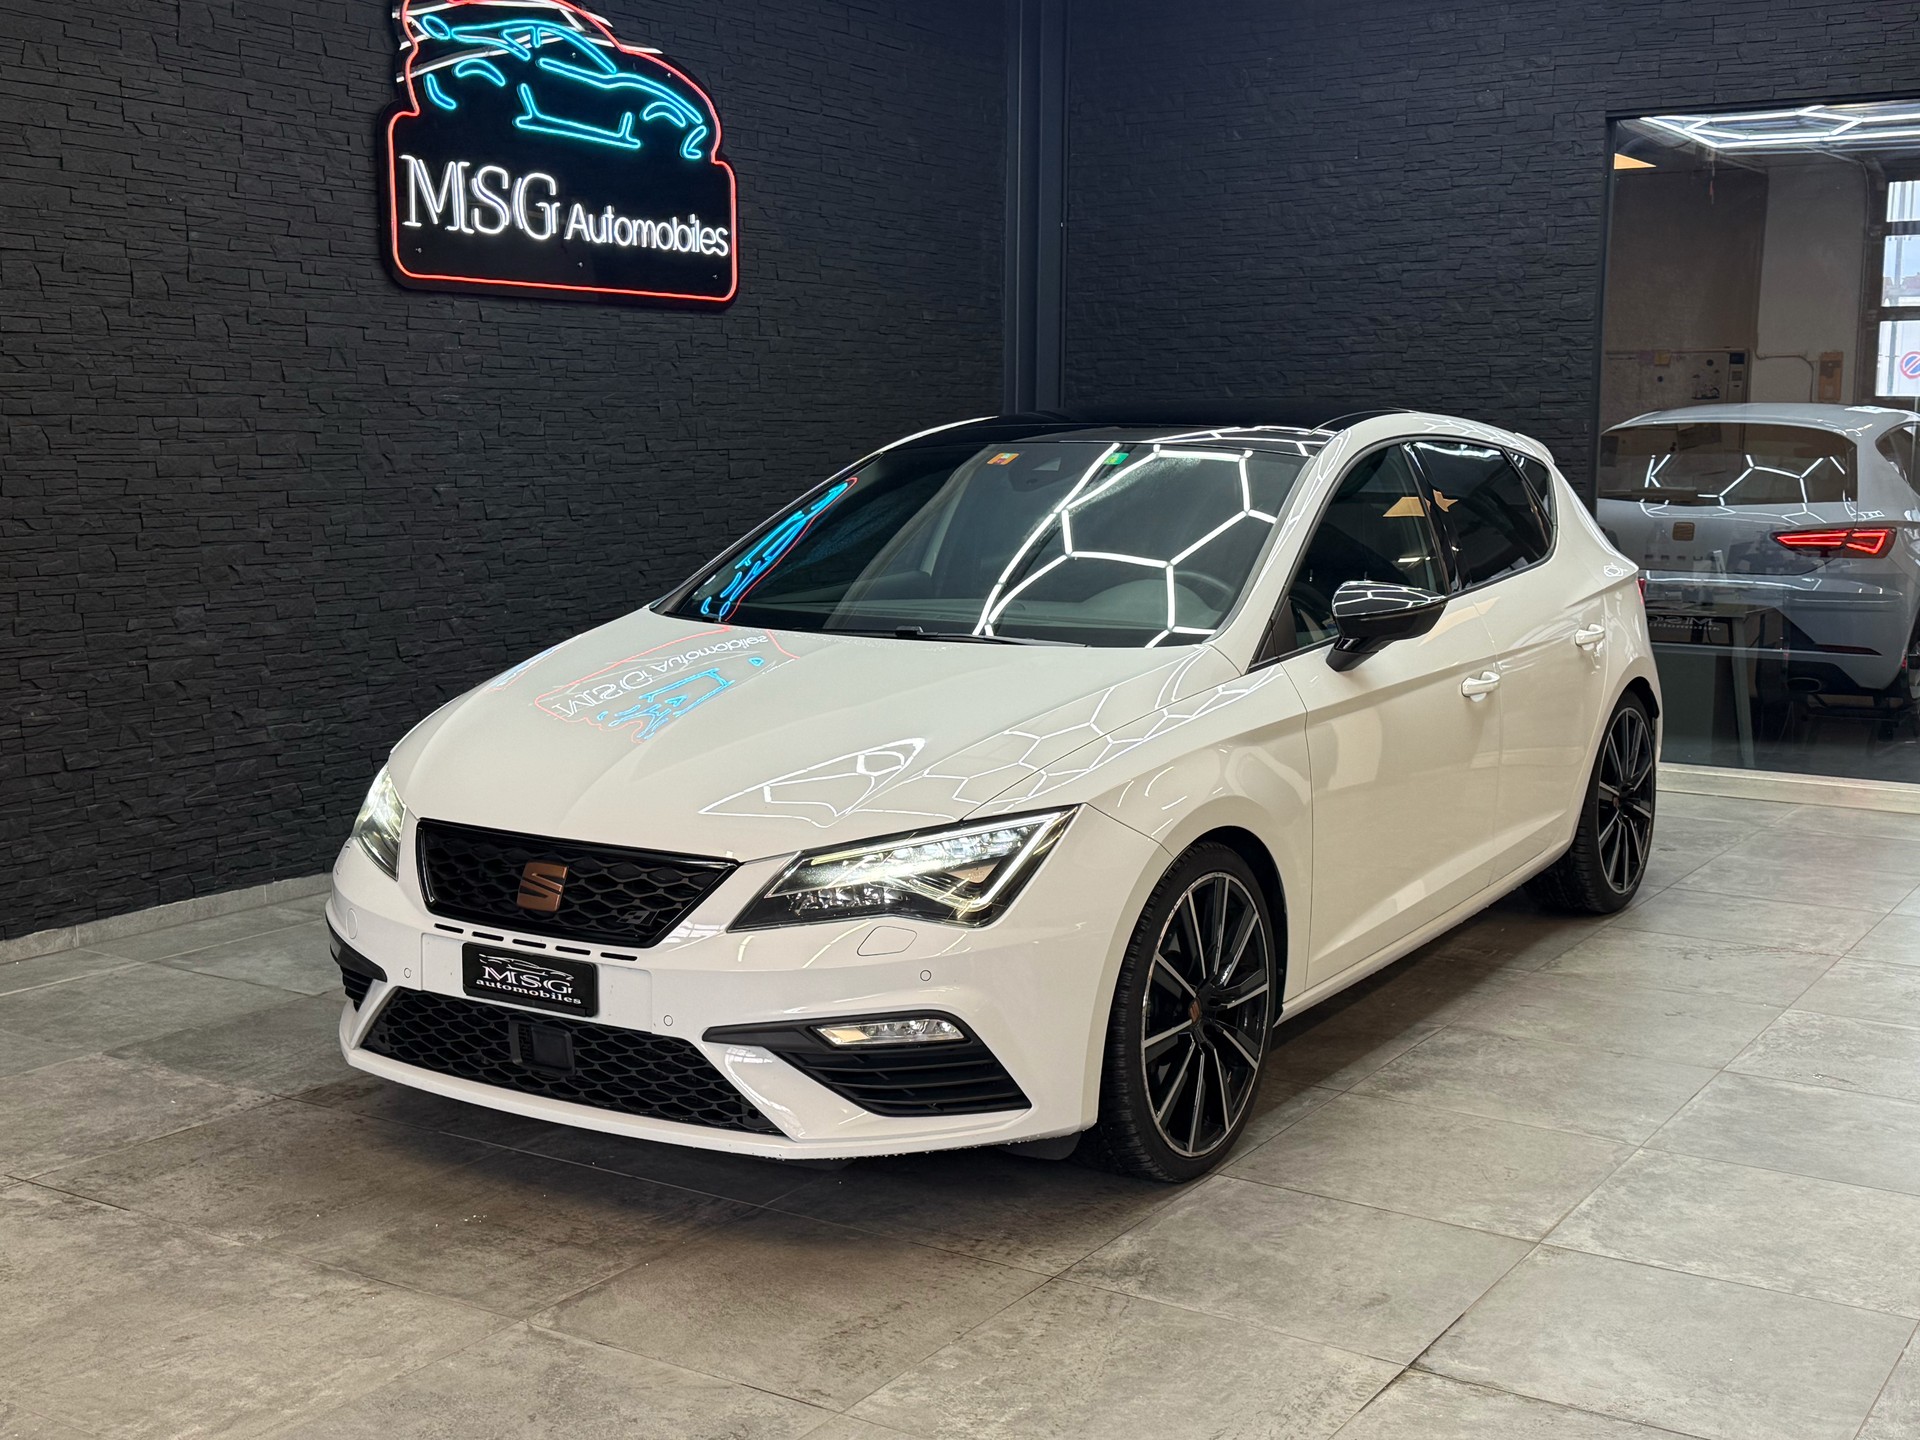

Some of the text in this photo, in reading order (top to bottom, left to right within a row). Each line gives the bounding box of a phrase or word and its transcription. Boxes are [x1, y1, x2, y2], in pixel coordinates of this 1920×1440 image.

[399, 154, 729, 257] MSG Automobiles
[476, 979, 582, 1005] automobiles
[482, 965, 574, 994] MSG
